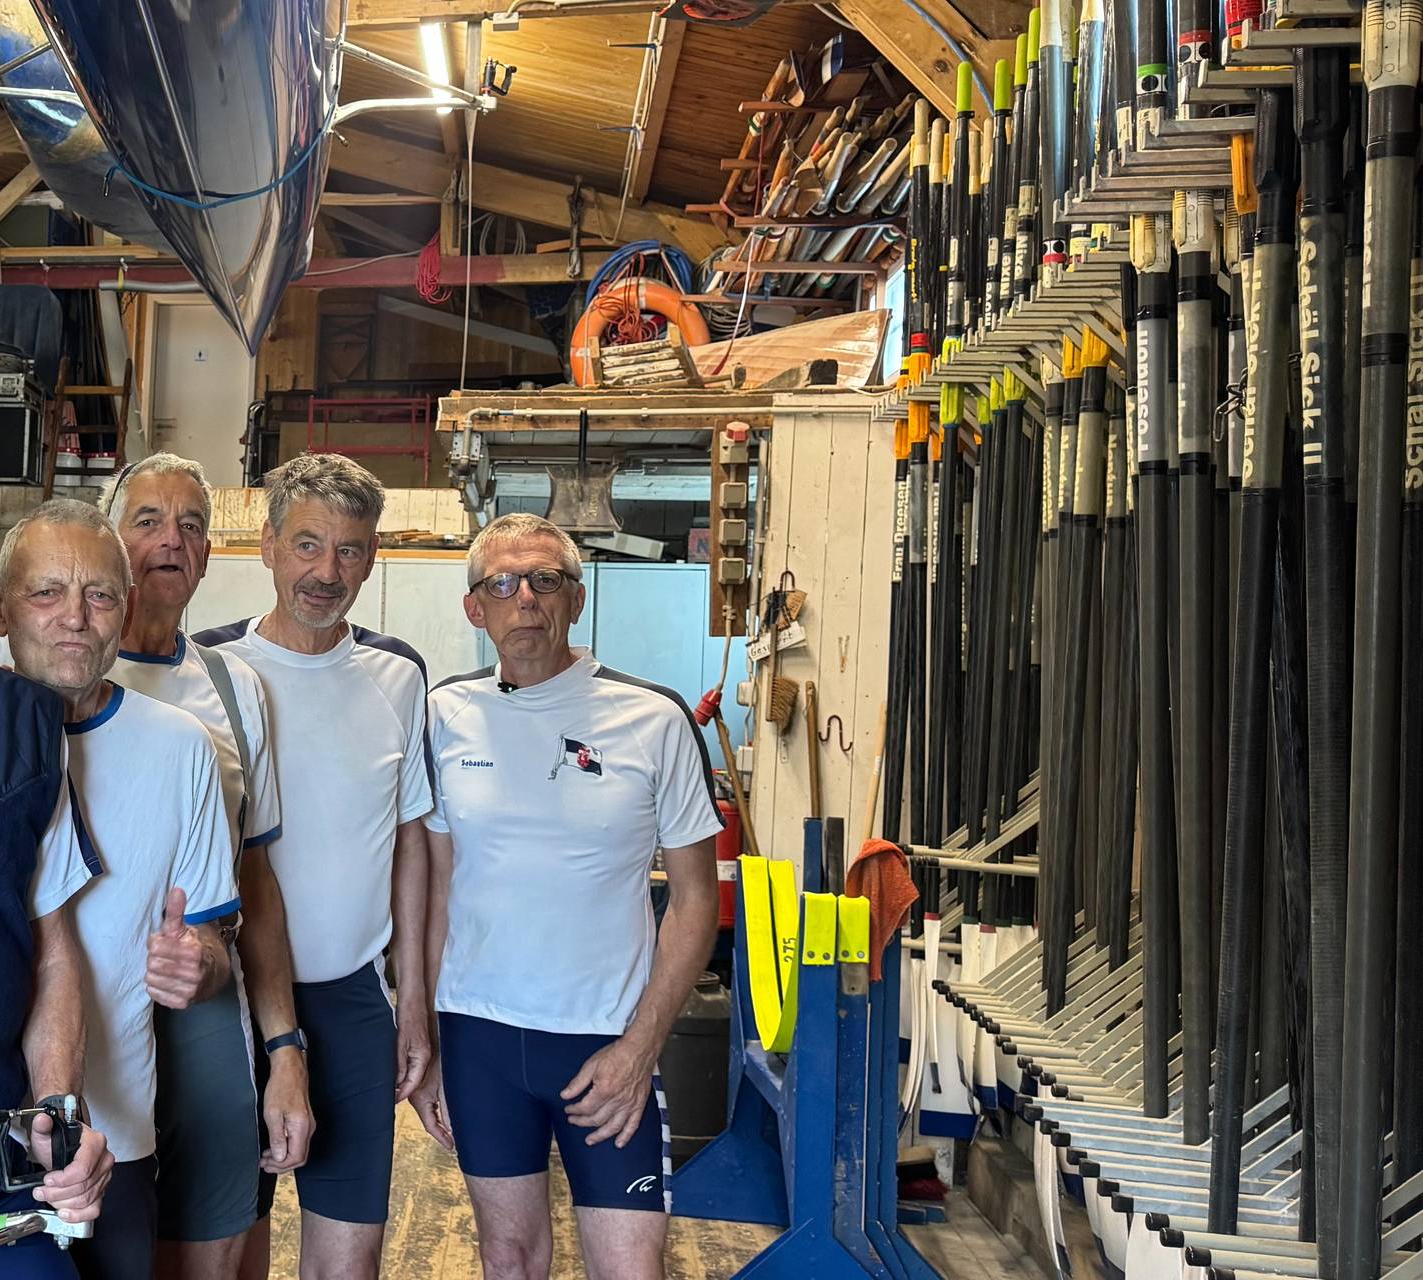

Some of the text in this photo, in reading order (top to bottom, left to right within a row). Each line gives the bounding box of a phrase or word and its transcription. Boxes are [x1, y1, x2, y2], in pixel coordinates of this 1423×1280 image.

[1300, 240, 1320, 339] Schäl
[1302, 352, 1321, 431] Sick
[893, 480, 907, 543] Dreesen
[893, 548, 904, 581] Frau
